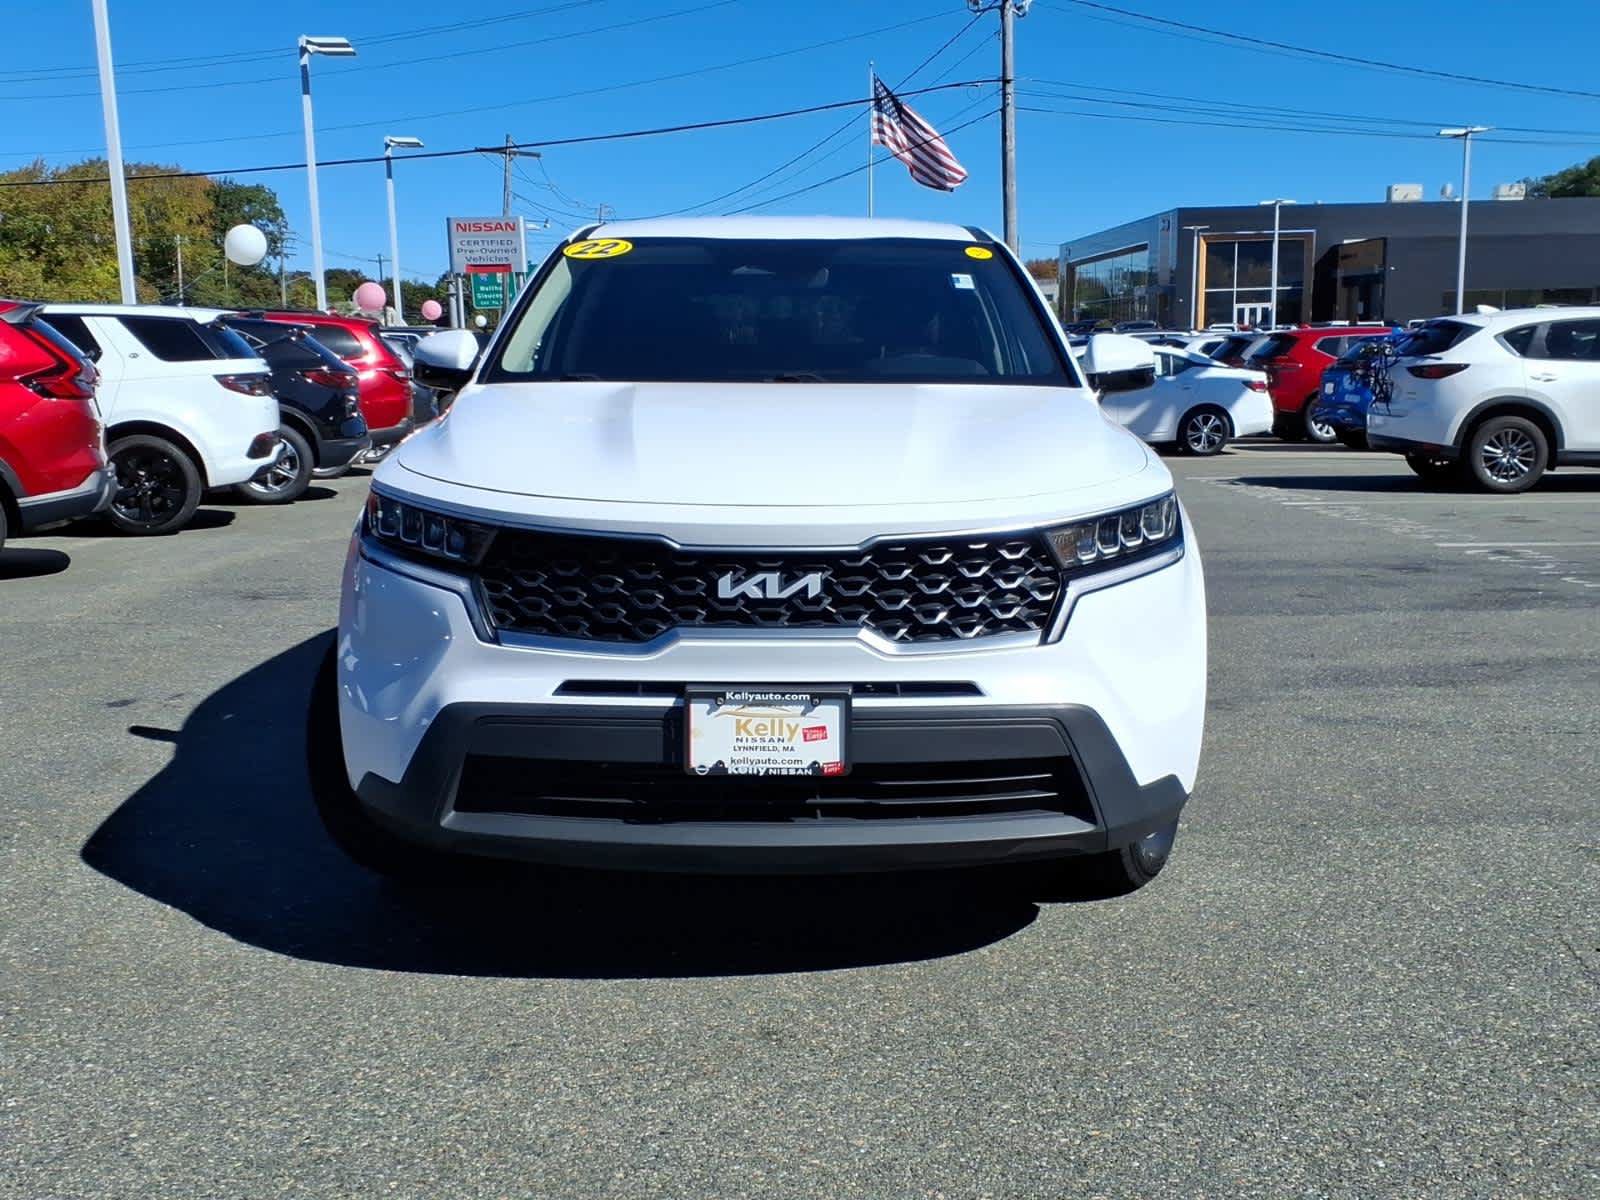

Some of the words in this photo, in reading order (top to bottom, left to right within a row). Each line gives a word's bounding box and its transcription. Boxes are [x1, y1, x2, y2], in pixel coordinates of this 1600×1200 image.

[456, 222, 516, 232] NISSAN
[459, 239, 513, 247] CERTIFIED
[456, 247, 518, 255] Pre-Owned
[465, 255, 510, 263] Vehicles
[718, 571, 821, 599] KIA
[725, 691, 810, 702] Kellyauto.com
[735, 718, 800, 743] Kelly
[733, 745, 779, 753] LYNNFIELD,
[730, 757, 803, 767] kellyauto.com
[728, 765, 766, 776] Kelly
